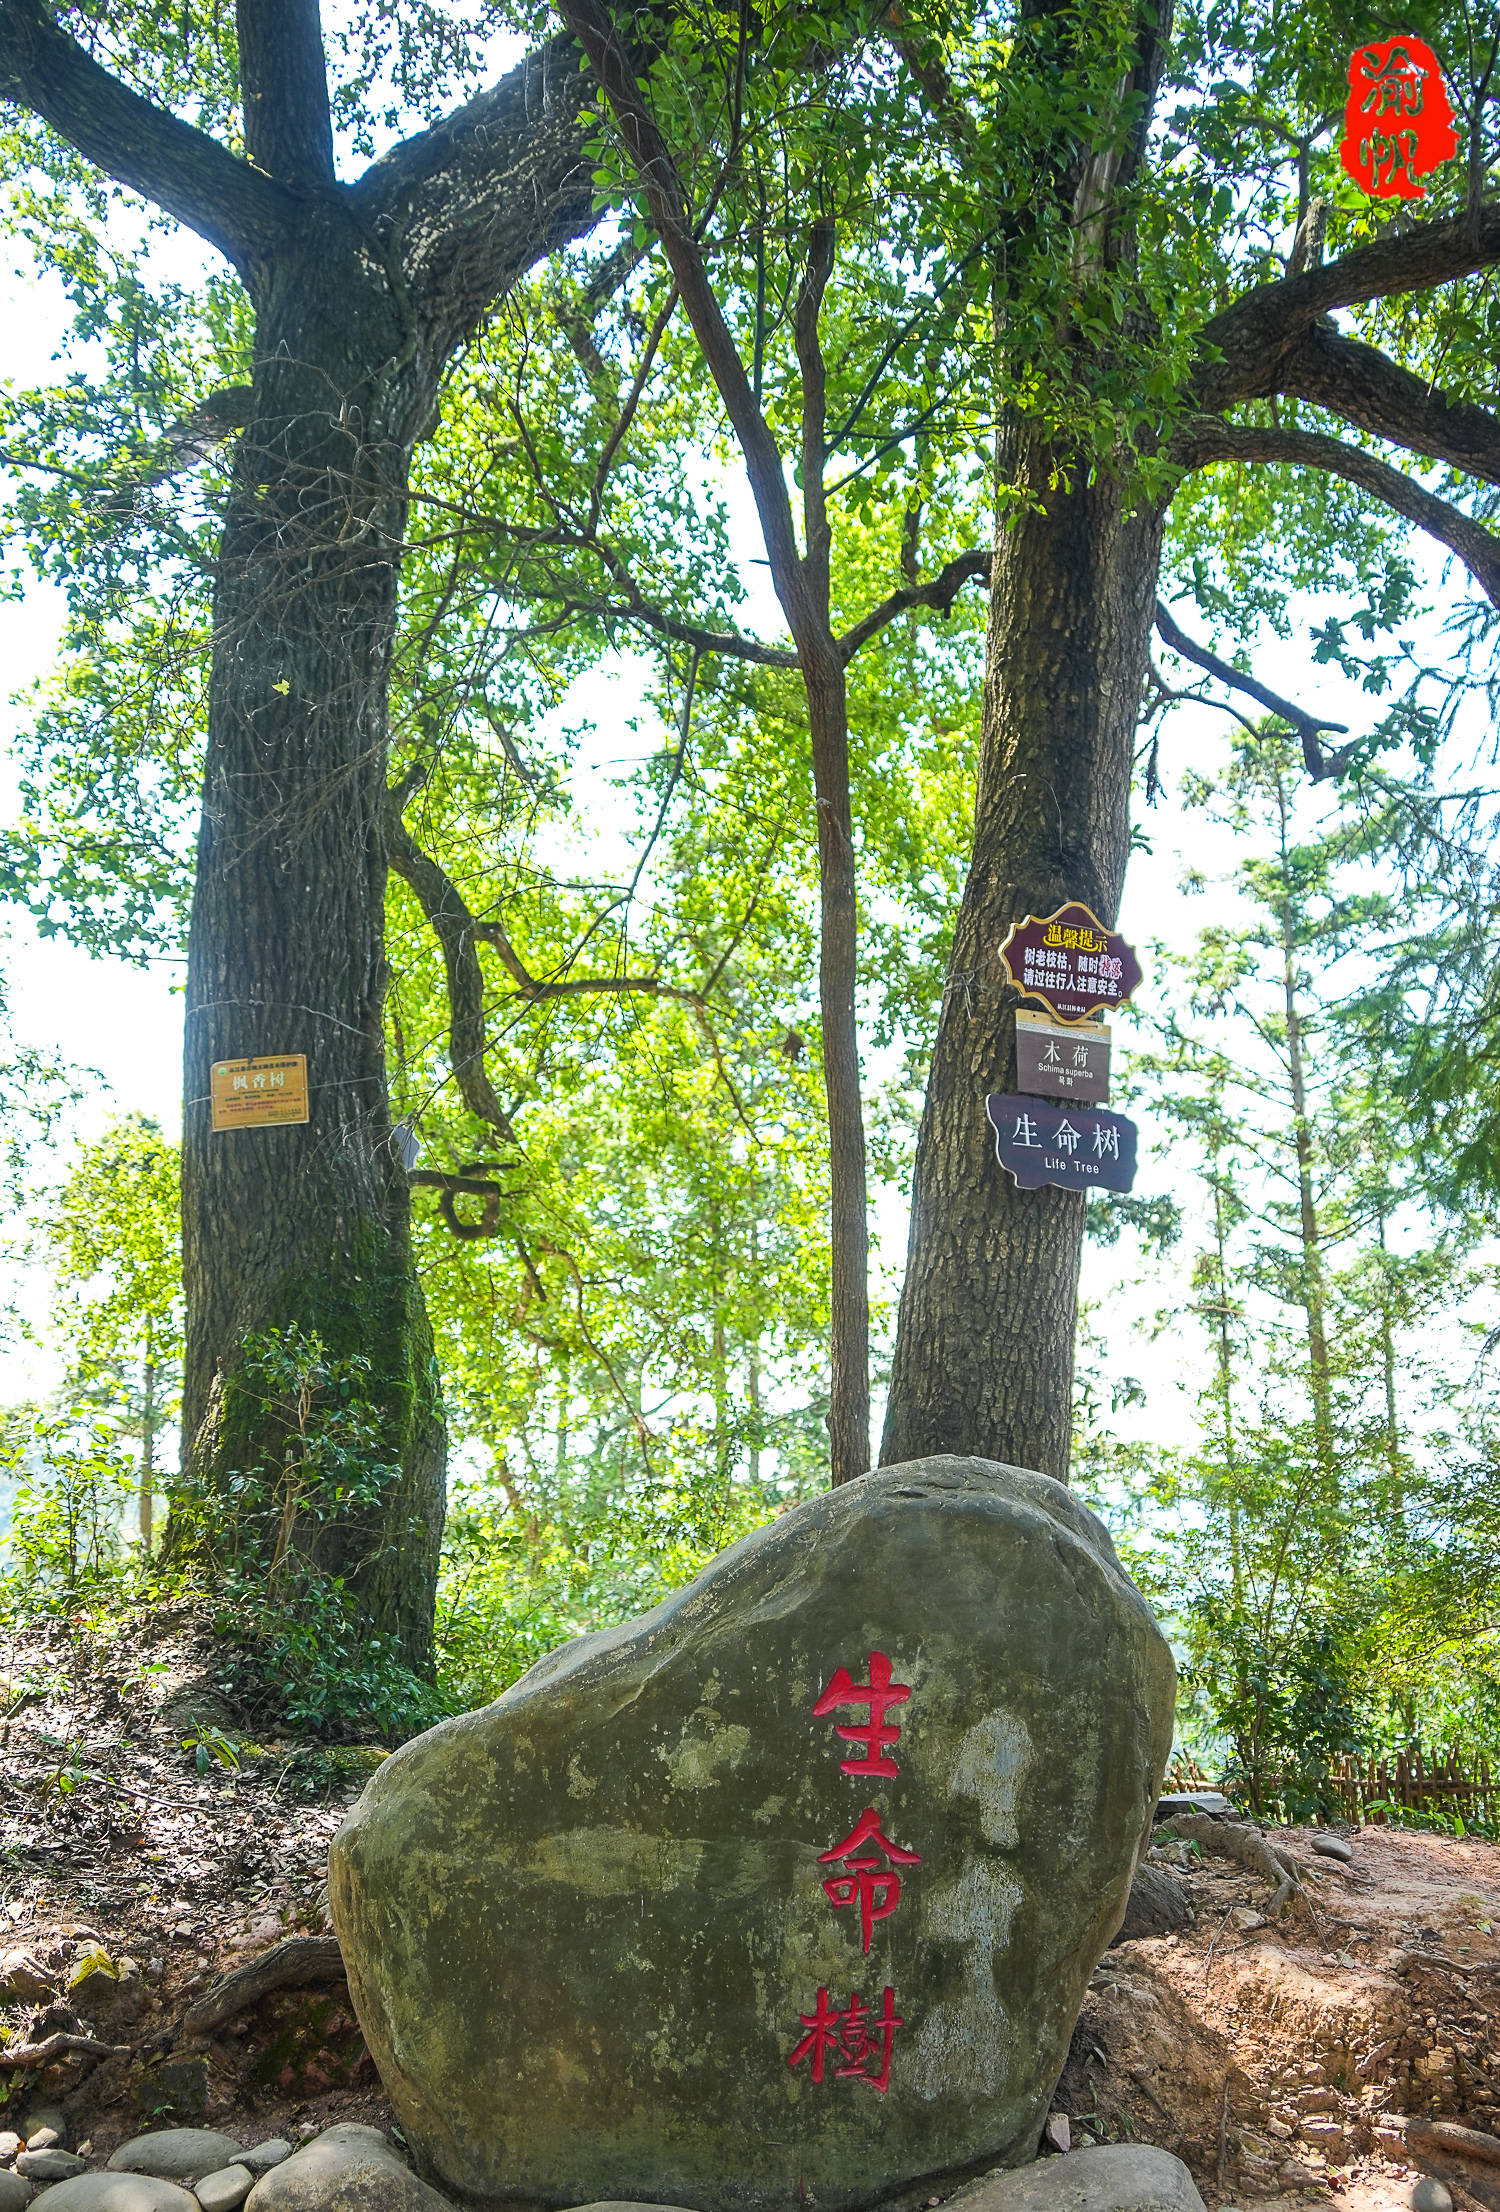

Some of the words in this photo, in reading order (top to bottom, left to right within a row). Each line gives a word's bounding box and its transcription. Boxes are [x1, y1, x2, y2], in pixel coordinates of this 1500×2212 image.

[1043, 923, 1108, 953] 温馨提示
[1023, 967, 1123, 998] 请过往行人注意安全。
[1043, 1040, 1089, 1068] 木荷
[233, 1071, 285, 1091] 枫香树
[1038, 1062, 1065, 1074] Schima
[1065, 1067, 1094, 1079] superba
[1012, 1113, 1121, 1161] 生命树
[1045, 1157, 1067, 1171] Life
[1074, 1160, 1100, 1174] Tree
[788, 1651, 922, 2094] 生命樹
